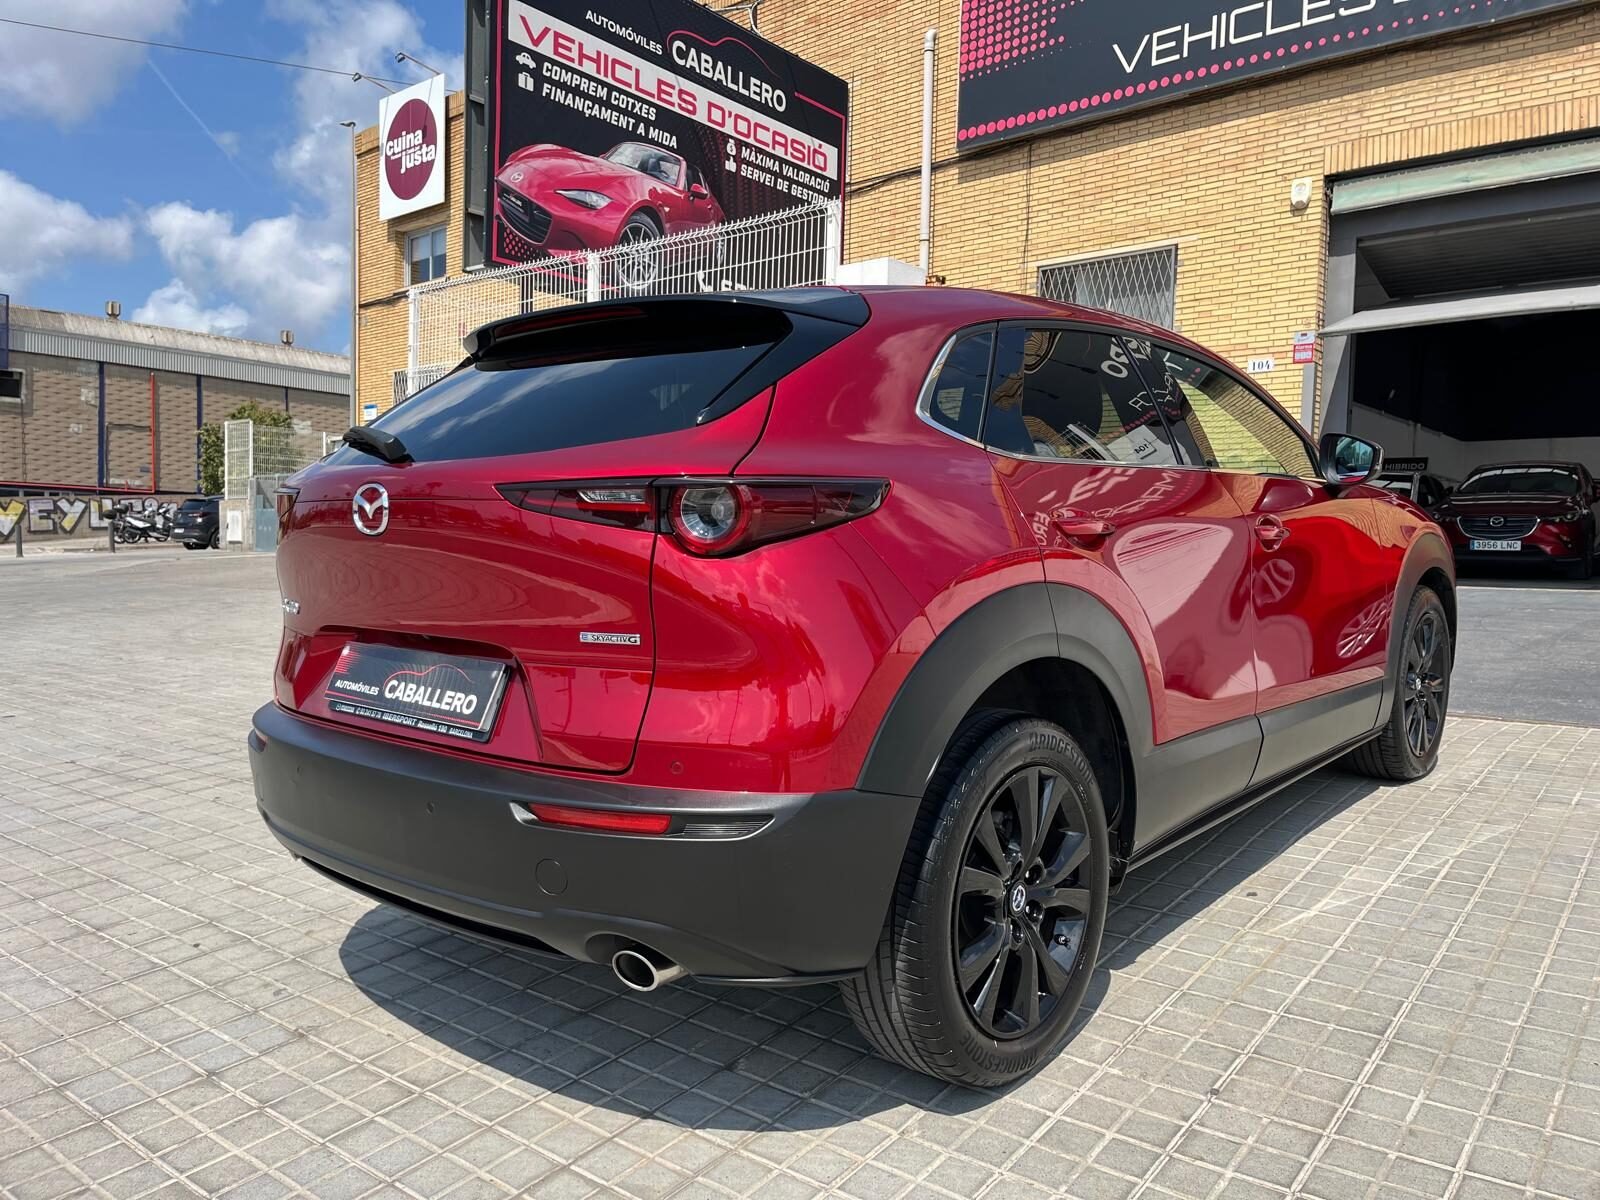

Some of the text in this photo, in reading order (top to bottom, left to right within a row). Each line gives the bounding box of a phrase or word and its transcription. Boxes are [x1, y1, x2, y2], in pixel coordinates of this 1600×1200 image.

[585, 10, 663, 56] AUTOMÓVILES
[519, 14, 828, 172] VEHICLES D'OCASIÓ
[542, 61, 657, 121] COMPREM COTXES
[672, 40, 787, 112] CABALLERO
[542, 82, 677, 149] FINANÇAMENT A MIDA
[386, 129, 423, 157] cuina
[400, 143, 436, 175] justa
[740, 164, 832, 208] SERVEI DE GESTORI
[741, 146, 830, 194] MÀXIMA VALORACIÓ
[1252, 360, 1271, 371] 104
[1475, 541, 1519, 550] 3956 LNC
[335, 679, 379, 695] AUTOMÓVILES
[384, 680, 478, 715] CABALLERO
